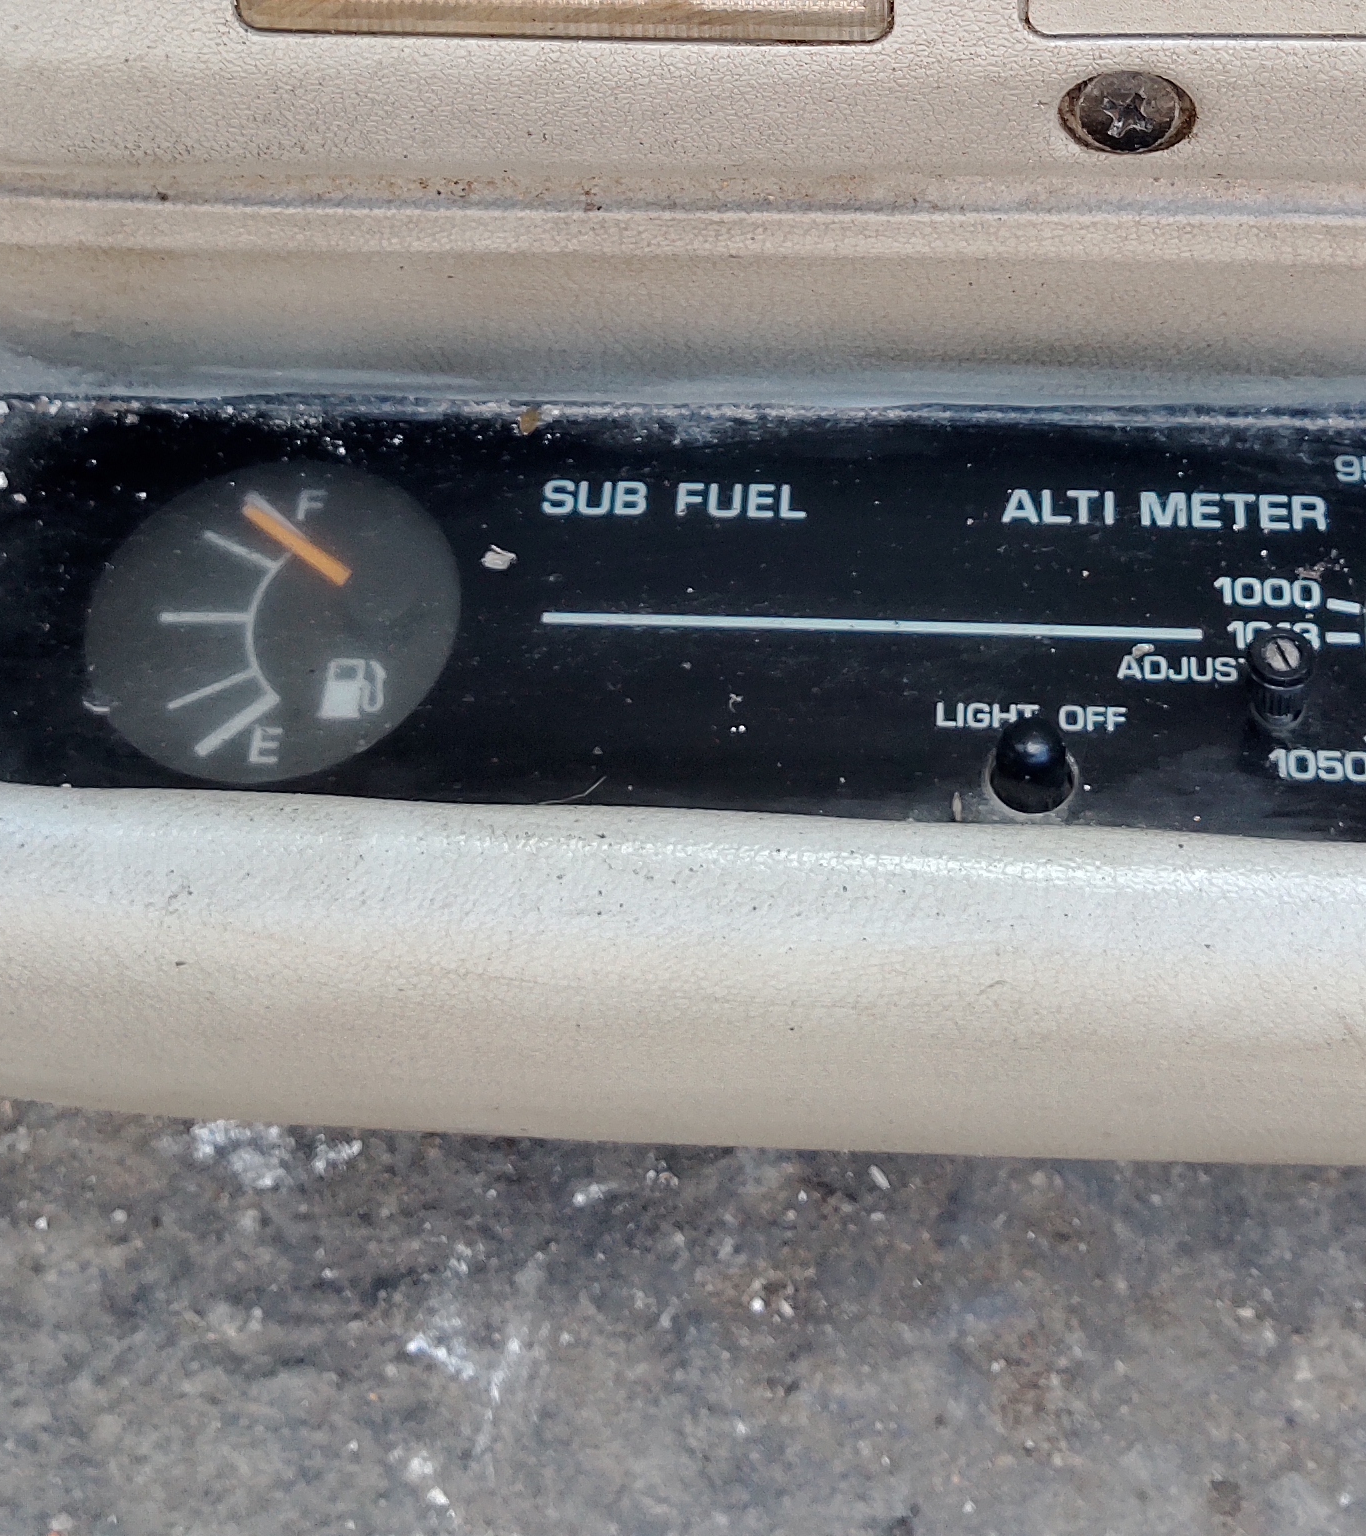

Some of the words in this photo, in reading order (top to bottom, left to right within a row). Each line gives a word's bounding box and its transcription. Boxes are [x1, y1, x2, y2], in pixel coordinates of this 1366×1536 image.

[295, 489, 328, 521] F
[541, 479, 647, 517] SUB
[675, 482, 807, 521] FUEL
[1002, 488, 1115, 526] ALTI
[1140, 491, 1328, 532] METER
[1214, 576, 1322, 609] 1000
[1117, 654, 1246, 682] ADJUS
[1058, 704, 1127, 732] OFF
[247, 725, 284, 764] E
